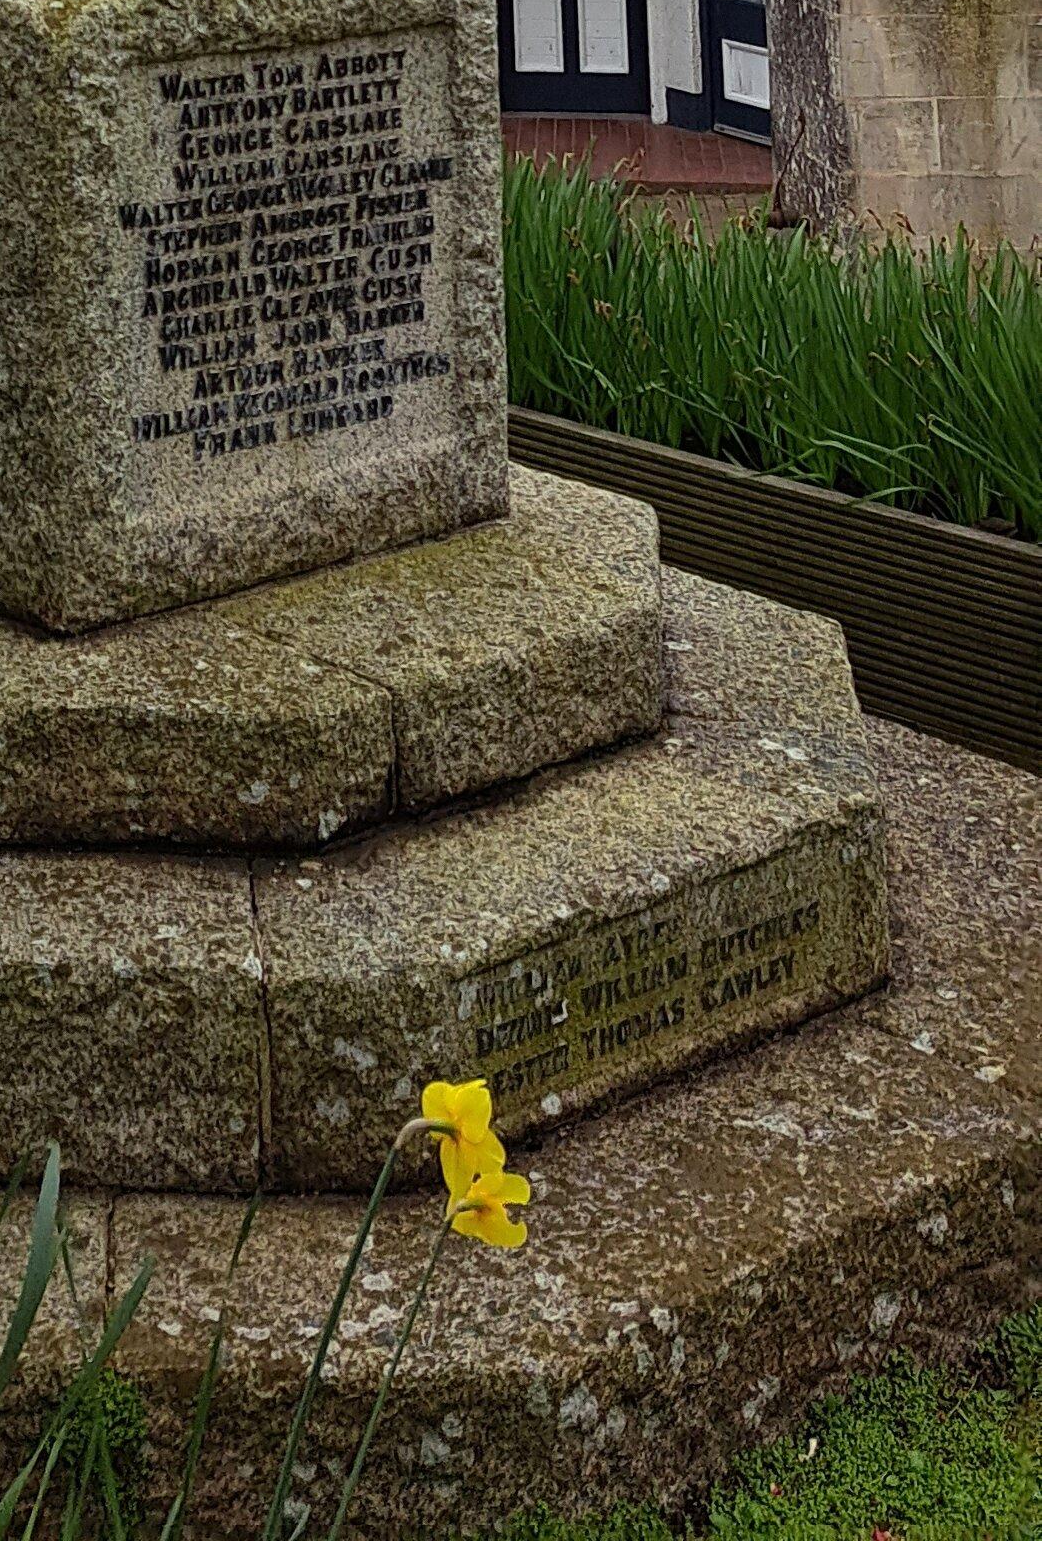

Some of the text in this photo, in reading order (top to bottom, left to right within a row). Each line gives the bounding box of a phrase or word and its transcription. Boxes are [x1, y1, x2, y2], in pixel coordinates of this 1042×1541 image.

[159, 50, 406, 102] WALTER TOM ABBOTT
[179, 78, 400, 130] ANTHONY BARTLETT
[179, 108, 403, 161] GEORGE CARSLAKE
[174, 138, 400, 192] WILLIAM CARSLAKE
[119, 198, 203, 230] WALTER
[208, 183, 286, 214] GEORGE
[146, 221, 241, 257] STEPHEN
[252, 203, 349, 238] AMBROSE
[142, 243, 431, 318] ARCHIBALD WALTER GUSH
[145, 250, 240, 288] NORMAN
[251, 234, 334, 267] GEORGE
[160, 305, 256, 343] CHARLIE
[362, 273, 422, 304] GUSH
[159, 332, 256, 373] WILLIAM
[194, 421, 276, 460] FRANK
[581, 997, 685, 1061] THOMAS
